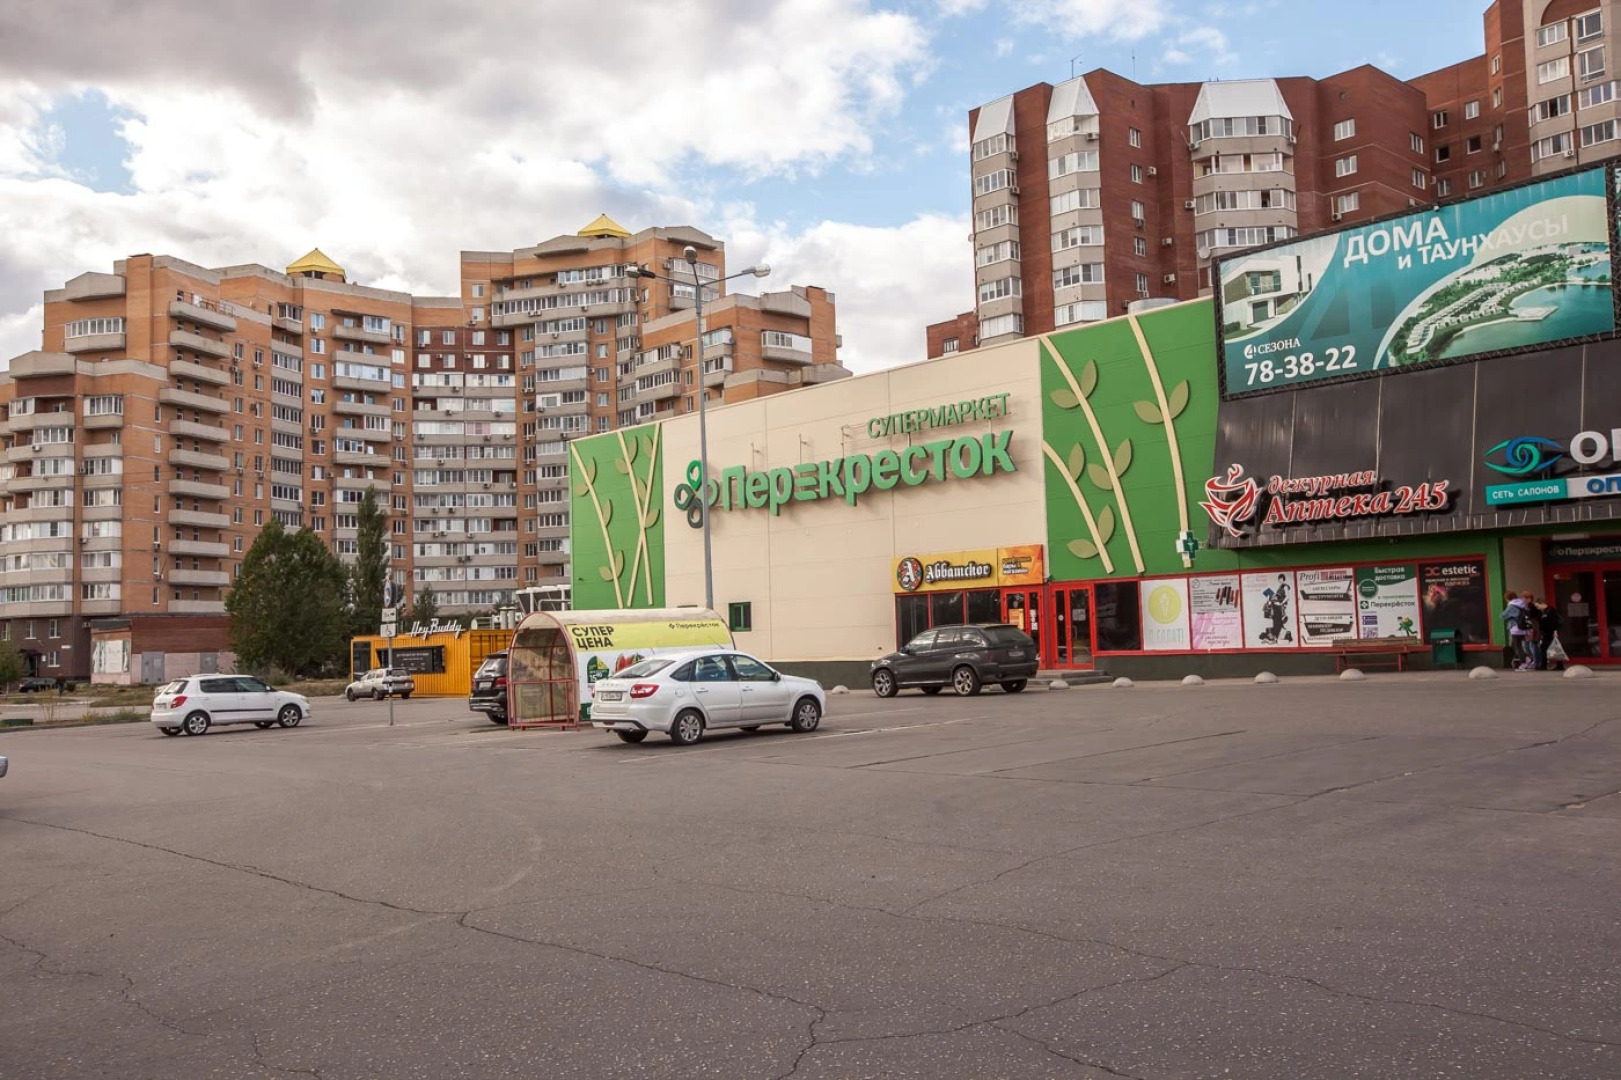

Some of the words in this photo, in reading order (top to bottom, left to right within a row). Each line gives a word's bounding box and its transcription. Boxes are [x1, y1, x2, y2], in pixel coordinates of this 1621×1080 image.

[1343, 216, 1448, 268] ДОМА
[1417, 214, 1568, 265] ТАУНХАУСЫ
[1258, 338, 1301, 354] СЕЗОНА
[1244, 345, 1358, 385] 78-38-22
[867, 393, 1011, 439] СУПЕРМАРКЕТ
[1267, 470, 1377, 497] дежурная
[1492, 490, 1514, 499] СЕТЬ
[1518, 485, 1559, 497] САЛОНОВ
[1264, 491, 1393, 524] Аптека
[1393, 480, 1450, 514] 245
[1441, 565, 1477, 575] estetic
[410, 620, 429, 640] Hey
[430, 618, 462, 639] Buddy
[572, 626, 614, 637] СУПЕР
[576, 637, 614, 650] ЦЕНА
